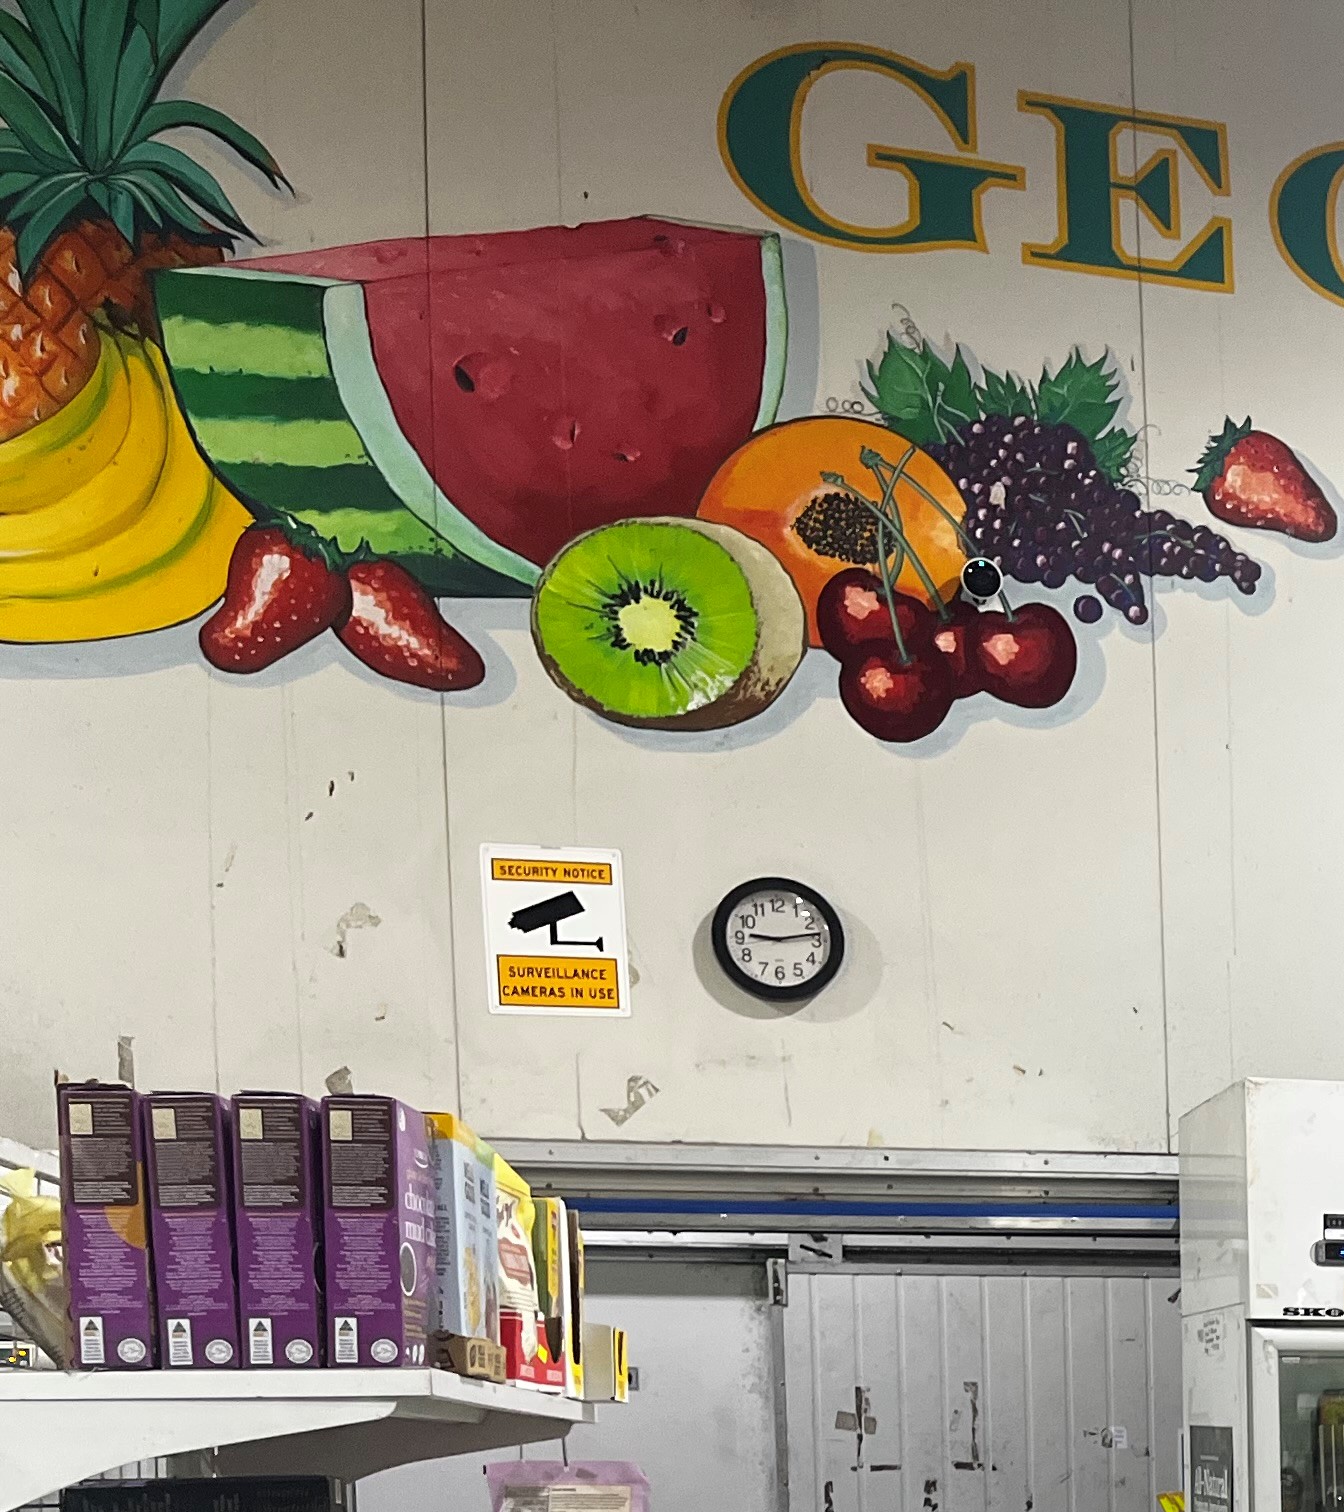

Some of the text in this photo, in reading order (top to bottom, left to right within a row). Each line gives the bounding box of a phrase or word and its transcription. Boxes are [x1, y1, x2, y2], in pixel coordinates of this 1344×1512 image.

[499, 865, 606, 880] SECURITY NOTICE
[769, 898, 786, 913] 12
[739, 913, 756, 929] 10
[734, 930, 745, 945] 9
[741, 948, 753, 963] 8
[805, 951, 817, 965] 4
[508, 965, 607, 981] SURVEILLANCE
[758, 962, 769, 976] 7
[774, 965, 786, 980] 6
[792, 962, 804, 978] 5
[502, 985, 615, 1001] CAMERAS IN USE
